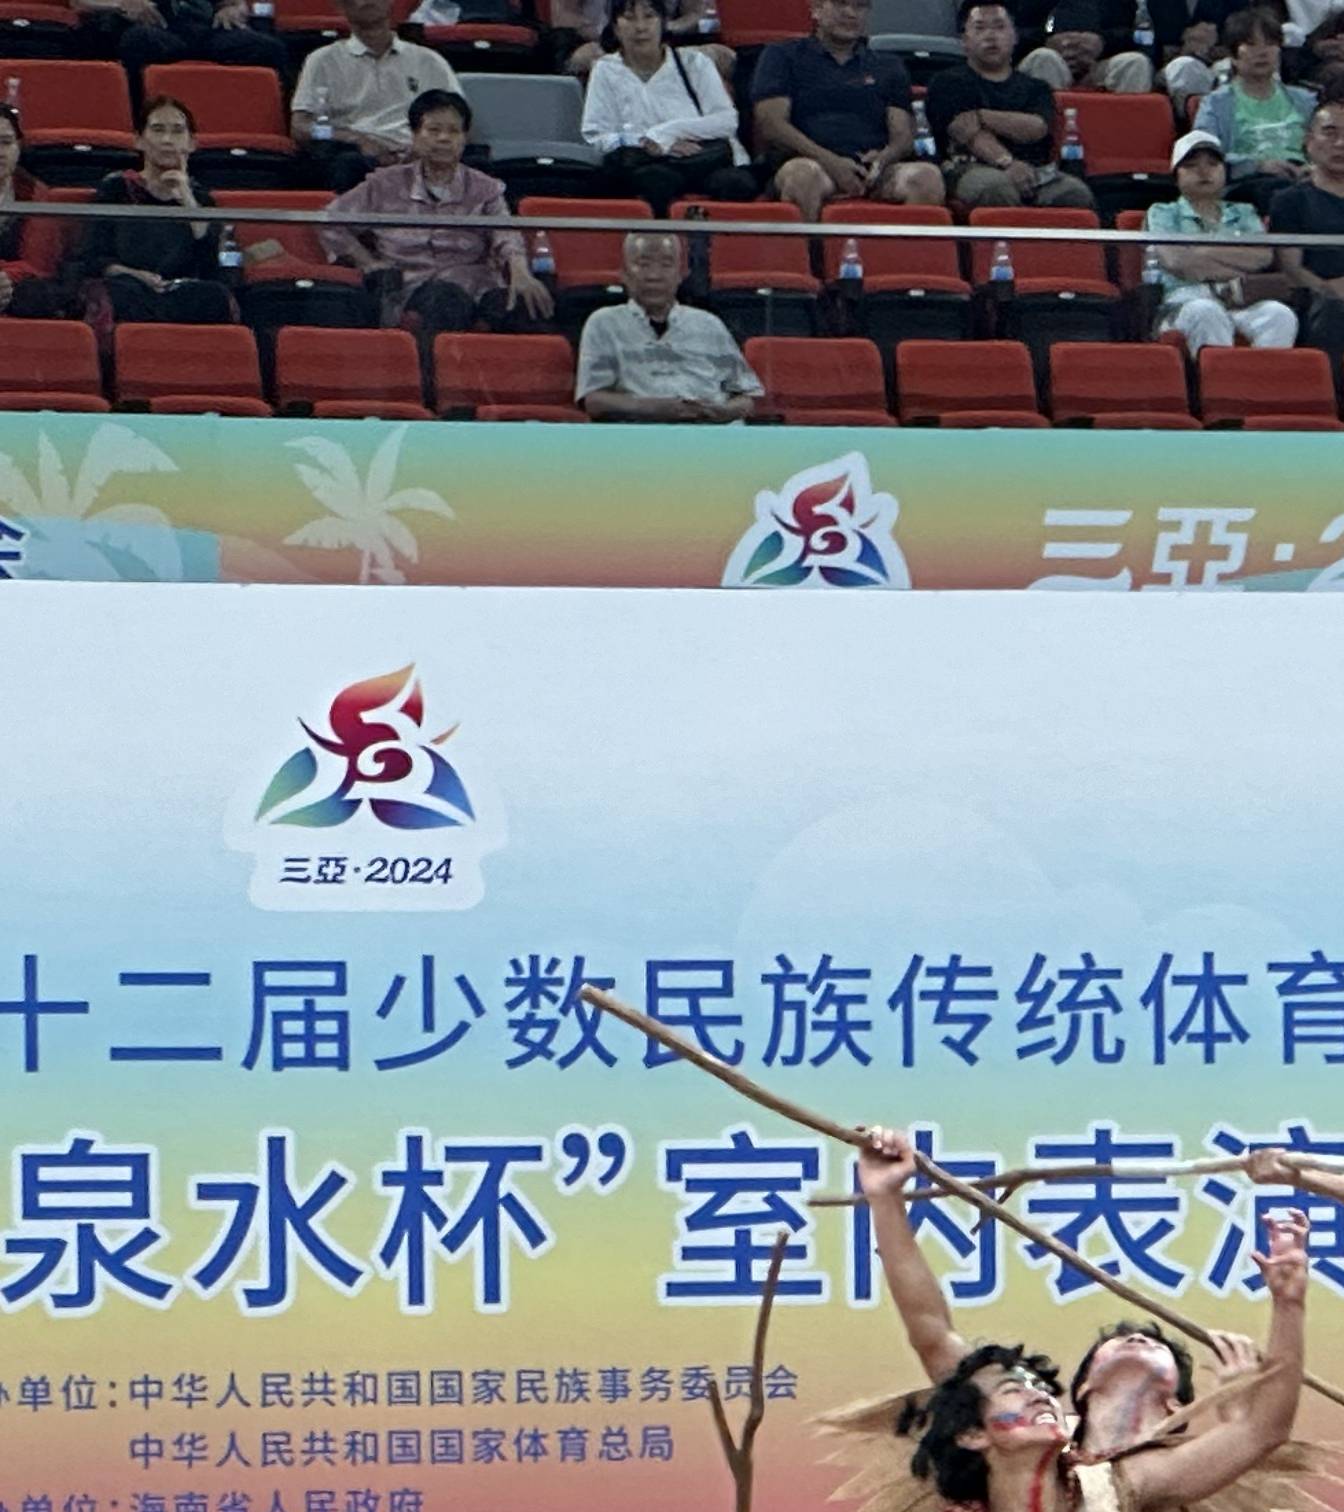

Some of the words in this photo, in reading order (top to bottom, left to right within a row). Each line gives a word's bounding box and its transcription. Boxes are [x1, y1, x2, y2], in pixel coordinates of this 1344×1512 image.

[0, 1363, 798, 1412] 单位：中华人民共和国国家民族事务委员会
[129, 1425, 674, 1470] 中华人民共和国国家体育总局
